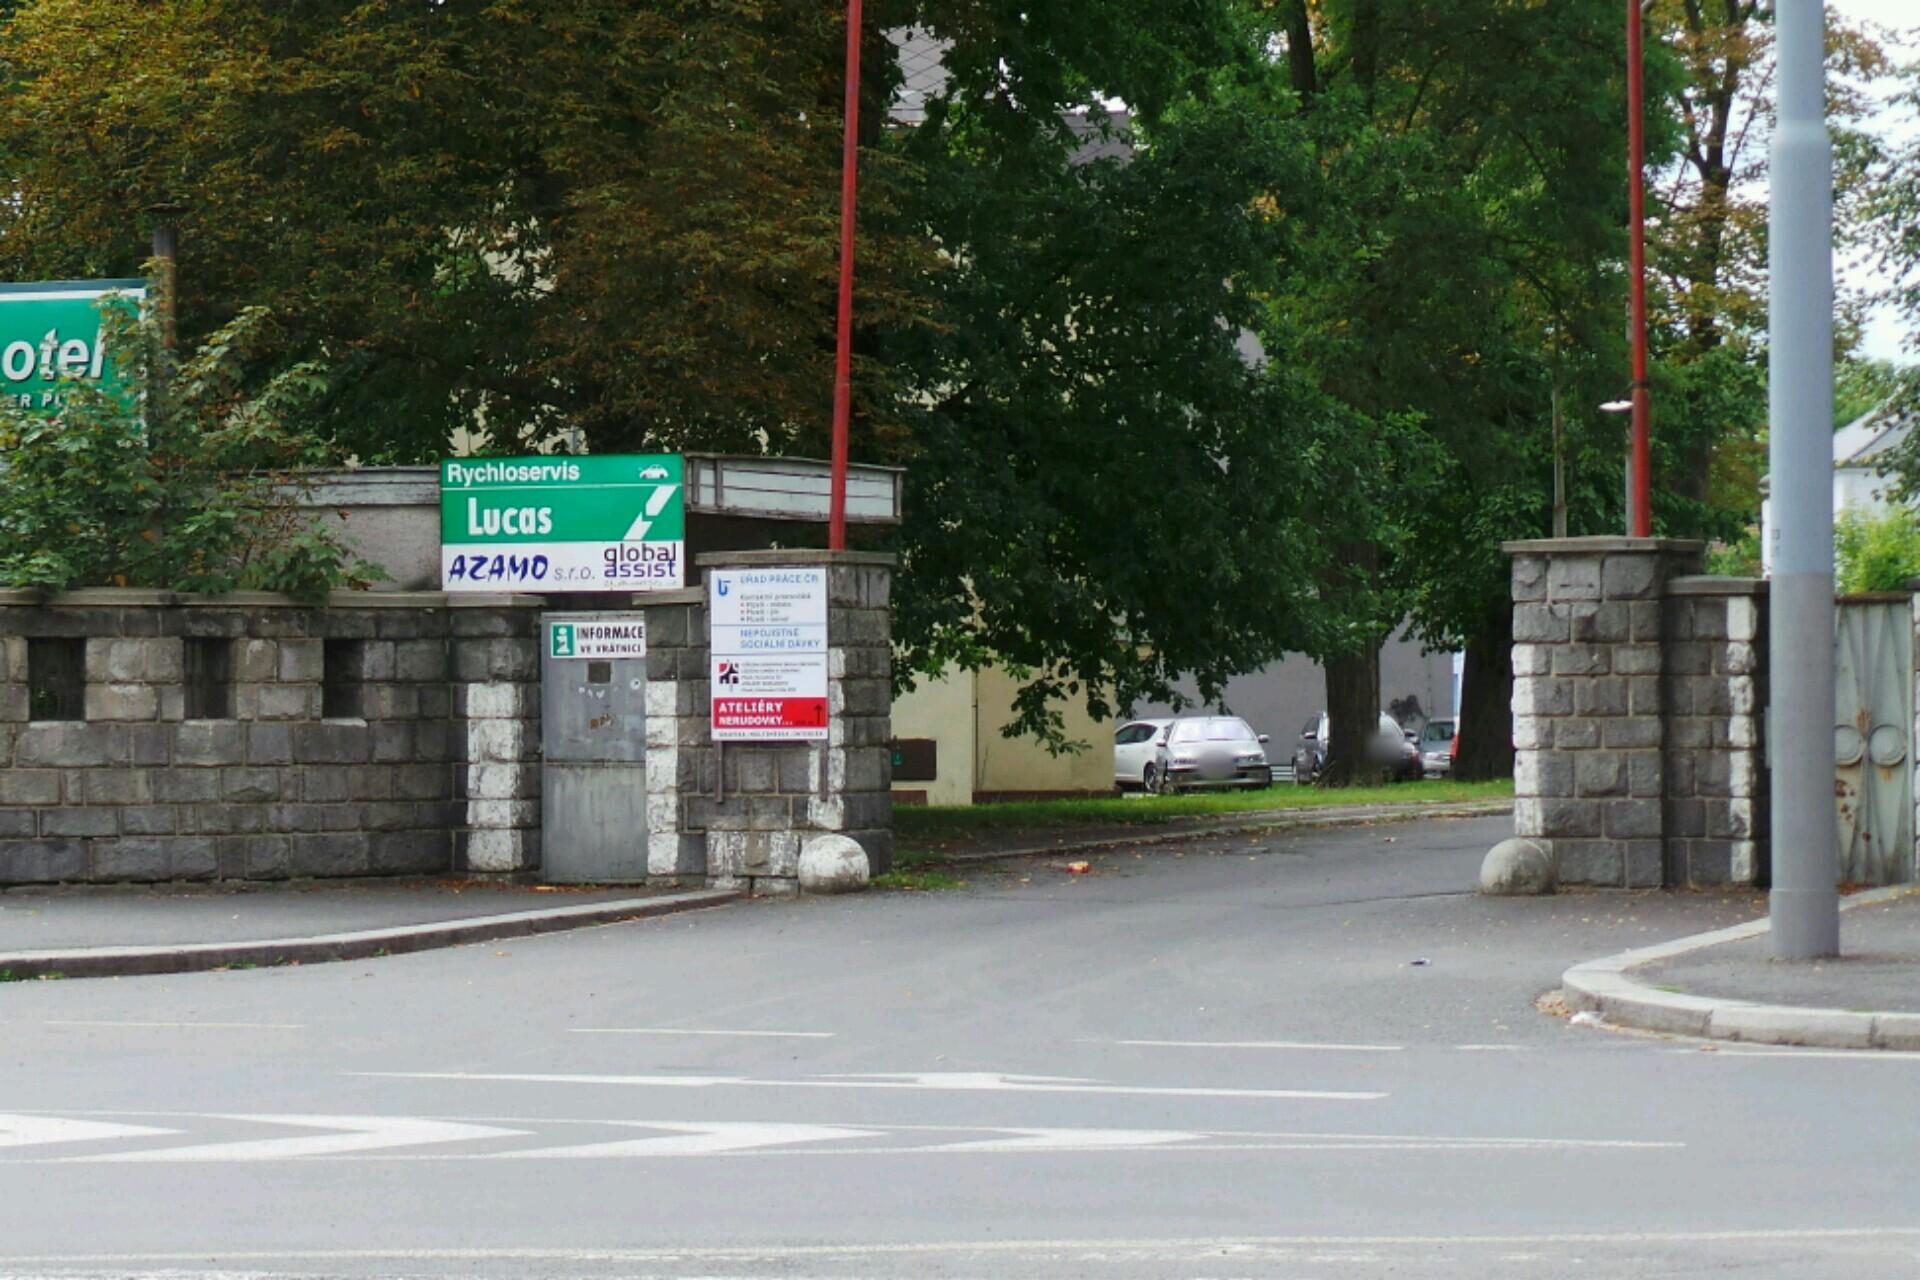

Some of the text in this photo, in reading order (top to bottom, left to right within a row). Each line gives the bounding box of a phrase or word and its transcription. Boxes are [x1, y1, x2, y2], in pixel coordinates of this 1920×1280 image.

[447, 461, 580, 487] Rychloservis
[468, 497, 552, 535] Lucas
[604, 543, 676, 565] global
[448, 554, 596, 582] AZAMO s.r.o.
[604, 559, 676, 578] assist
[576, 626, 643, 640] INFORMACE
[719, 699, 783, 713] ATELIÉRY
